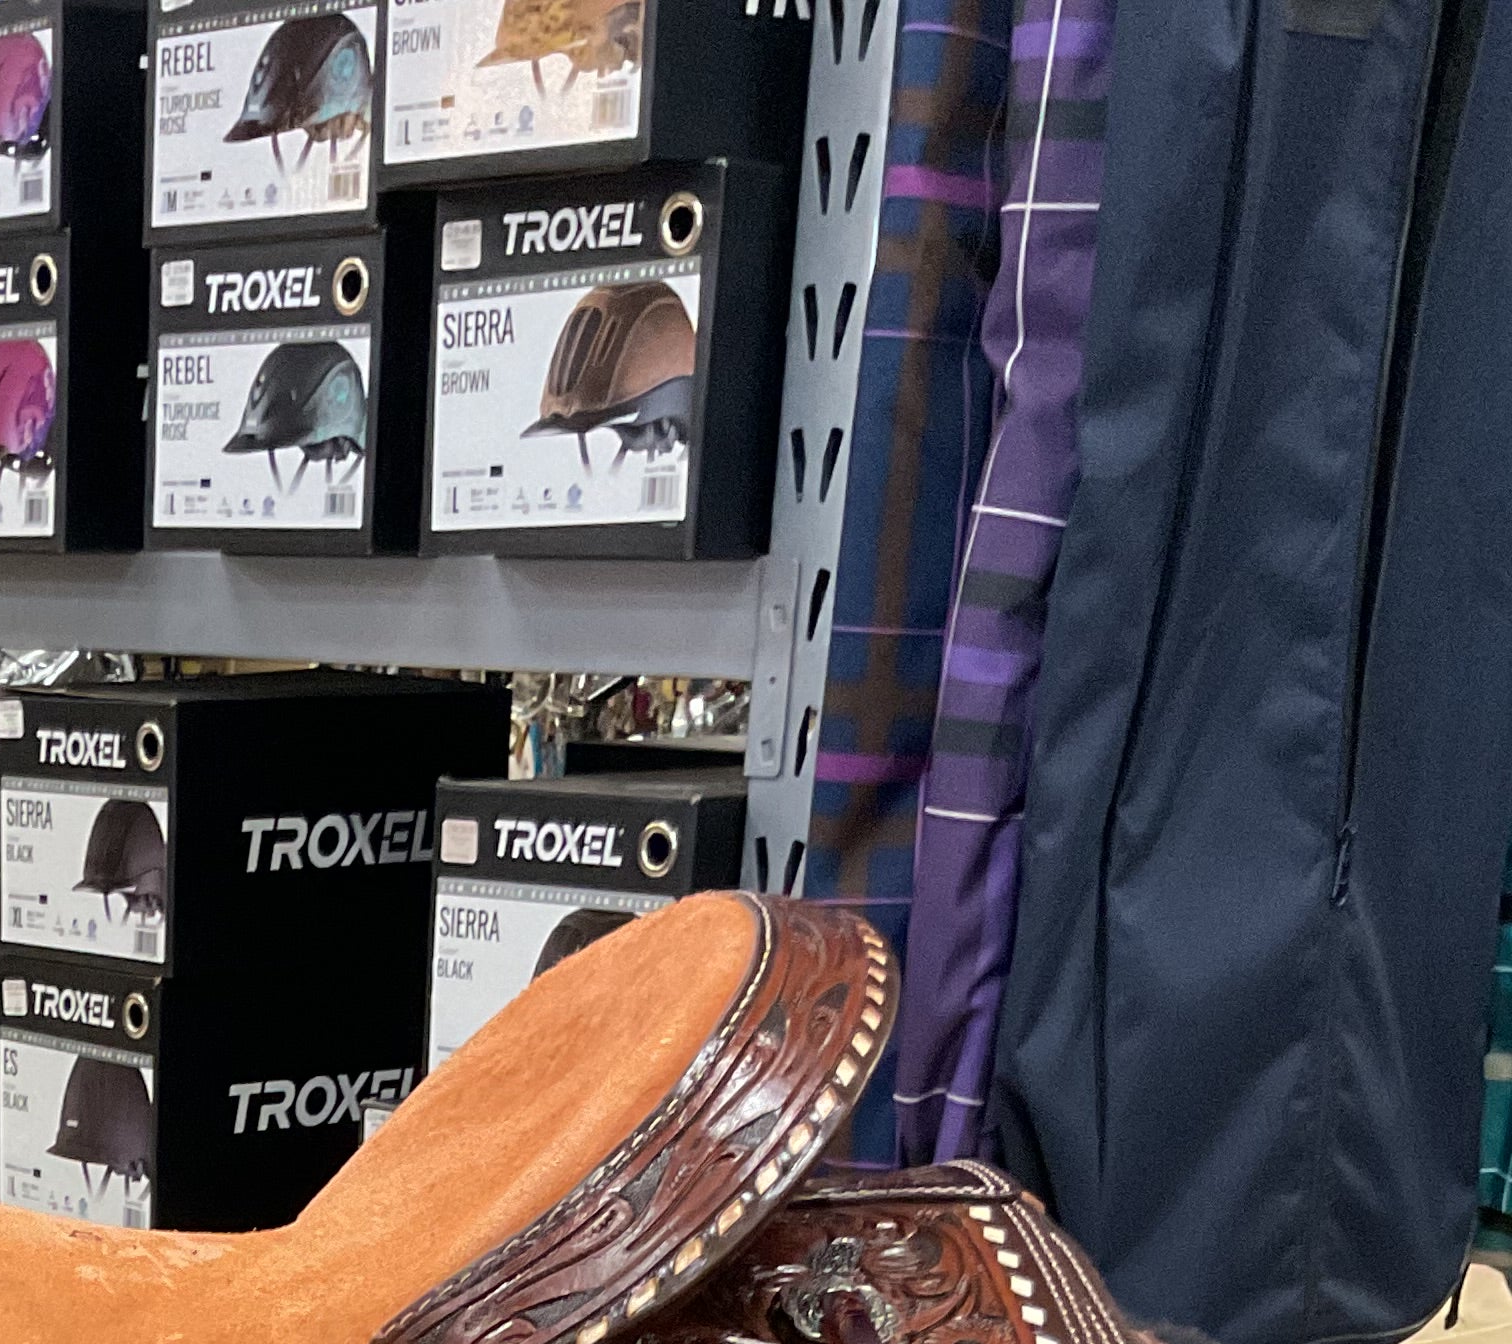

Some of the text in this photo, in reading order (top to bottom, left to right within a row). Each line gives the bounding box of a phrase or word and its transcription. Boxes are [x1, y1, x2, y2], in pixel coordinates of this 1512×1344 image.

[392, 25, 441, 56] BROWN
[161, 41, 215, 78] REBEL
[159, 90, 222, 115] TURQUOISE
[503, 202, 642, 255] TROXEL
[205, 267, 320, 313] TROXEL
[443, 307, 514, 350] SIERRA
[162, 355, 214, 385] REBEL
[441, 369, 490, 395] BROWN
[162, 401, 220, 422] TURQUOISE
[162, 422, 189, 441] ROSE
[36, 730, 126, 768] TROXEL
[6, 799, 53, 830] SIERRA
[6, 843, 34, 863] BLACK
[241, 809, 433, 873] TROXEL
[494, 820, 624, 867] TROXEL
[439, 906, 500, 942] SIERRA
[437, 958, 473, 980] BLACK
[31, 983, 115, 1029] TROXEL
[4, 1048, 18, 1076] ES
[3, 1092, 29, 1112] BLACK
